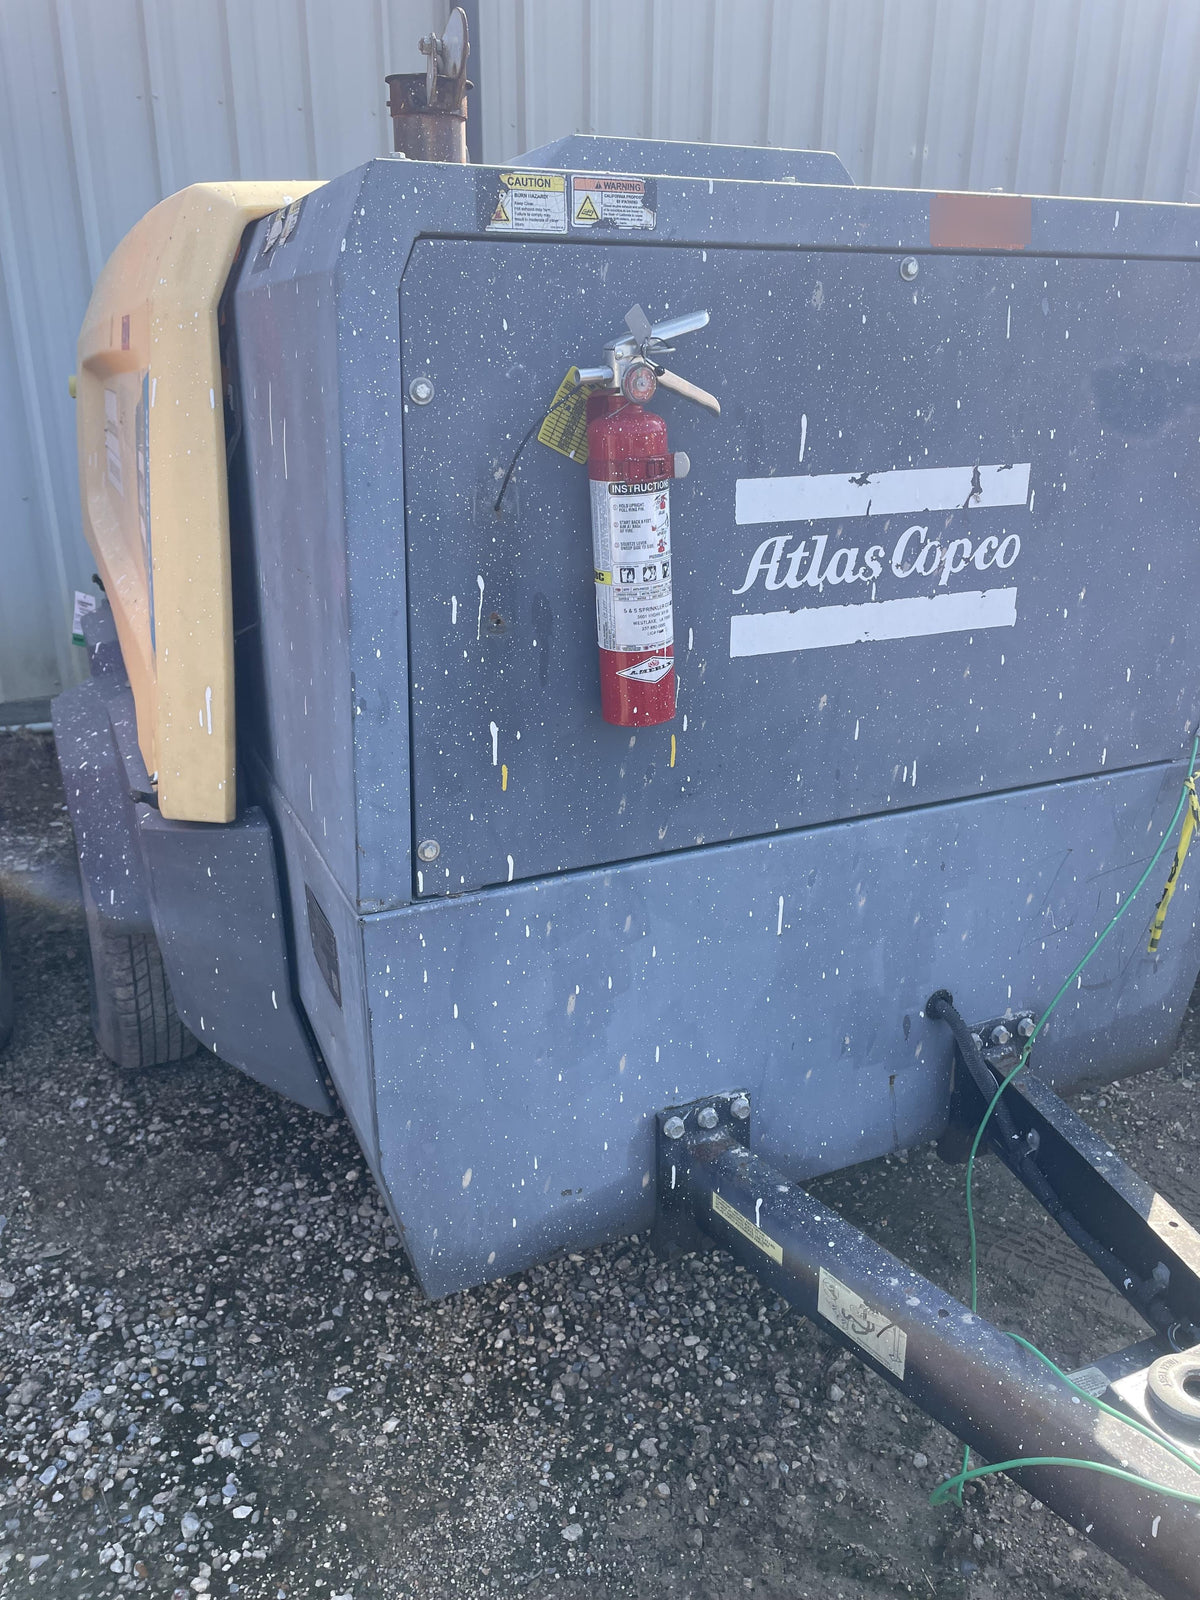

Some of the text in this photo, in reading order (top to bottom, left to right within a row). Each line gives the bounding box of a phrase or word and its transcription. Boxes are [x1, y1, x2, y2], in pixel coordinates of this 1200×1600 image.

[507, 176, 551, 188] CAUTION
[603, 181, 641, 191] WARNING
[732, 525, 1021, 595] Atlas Copco
